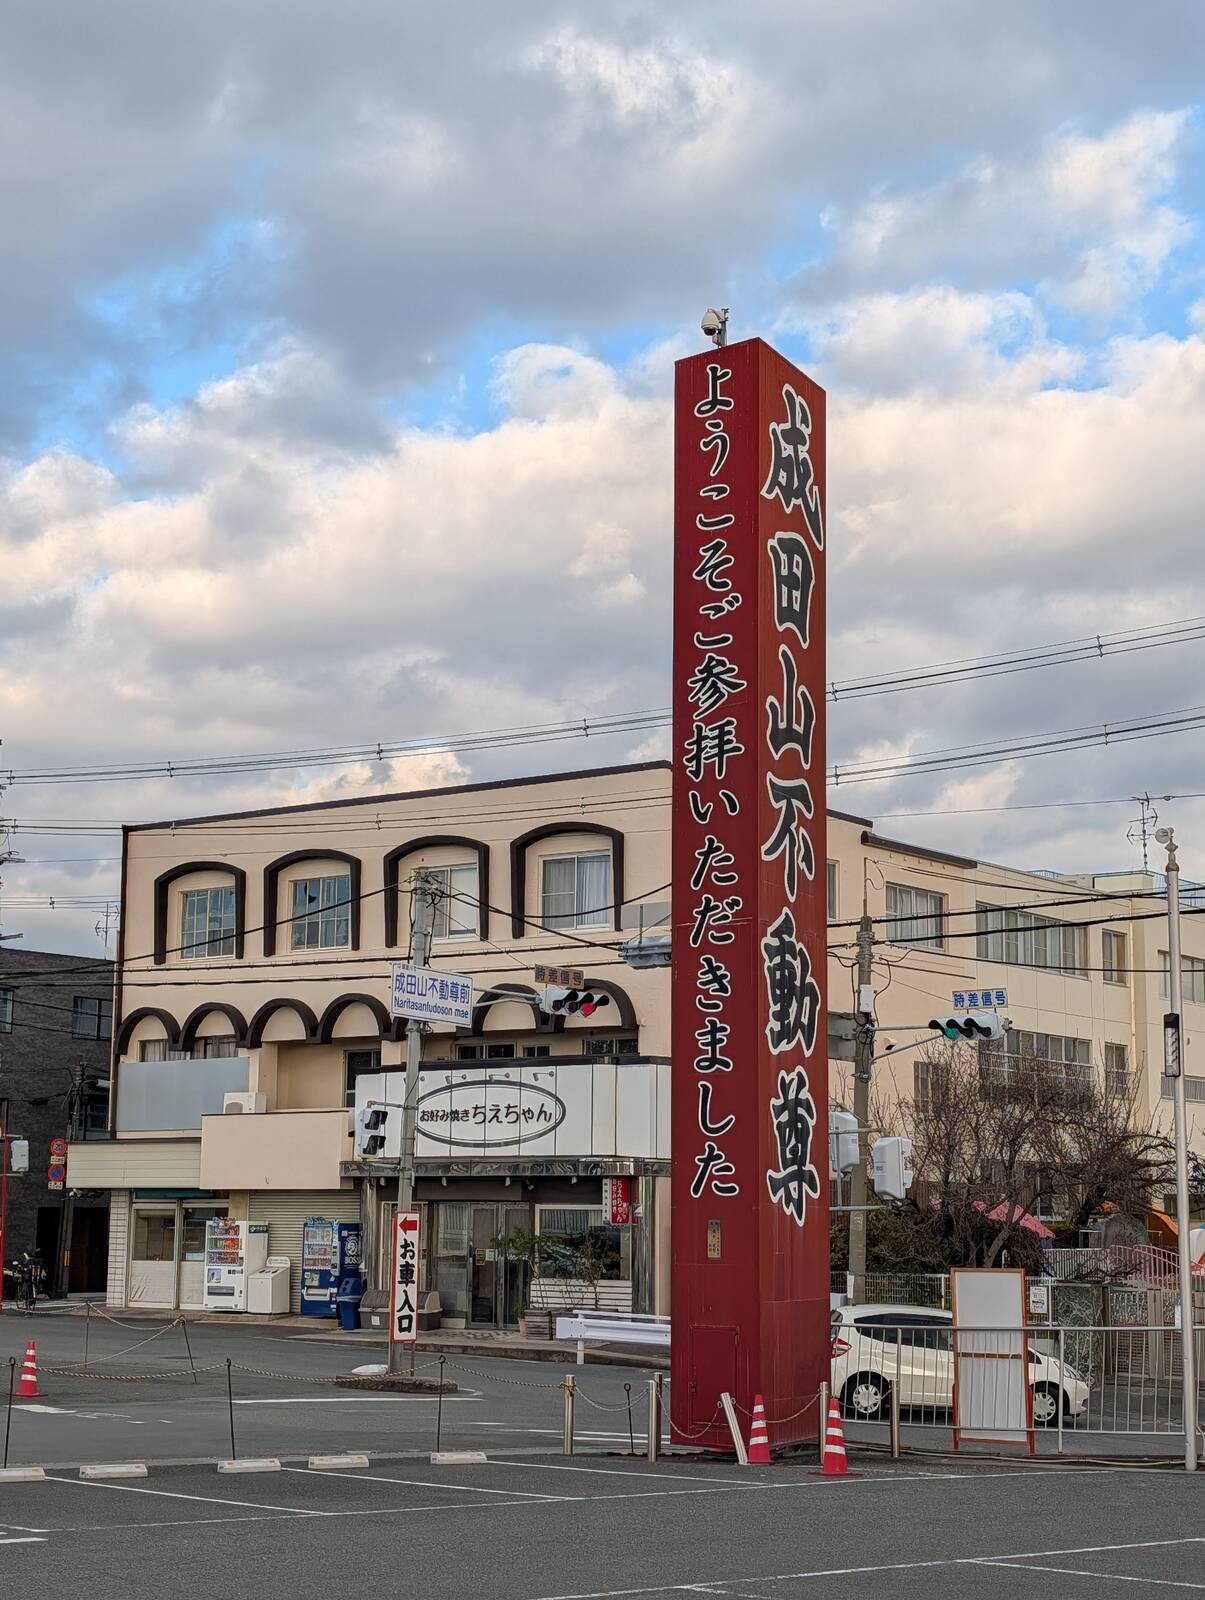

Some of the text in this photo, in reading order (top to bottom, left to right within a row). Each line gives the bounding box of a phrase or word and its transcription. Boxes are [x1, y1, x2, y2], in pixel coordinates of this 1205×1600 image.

[683, 363, 747, 1199] ようこそご参拝いただきました
[760, 383, 825, 1227] 成田山不動尊
[394, 972, 470, 1004] 成田山不動尊前
[394, 995, 469, 1019] Naritasanfudoson mae
[953, 990, 1006, 1008] 時差信号
[396, 1238, 416, 1333] お車入口
